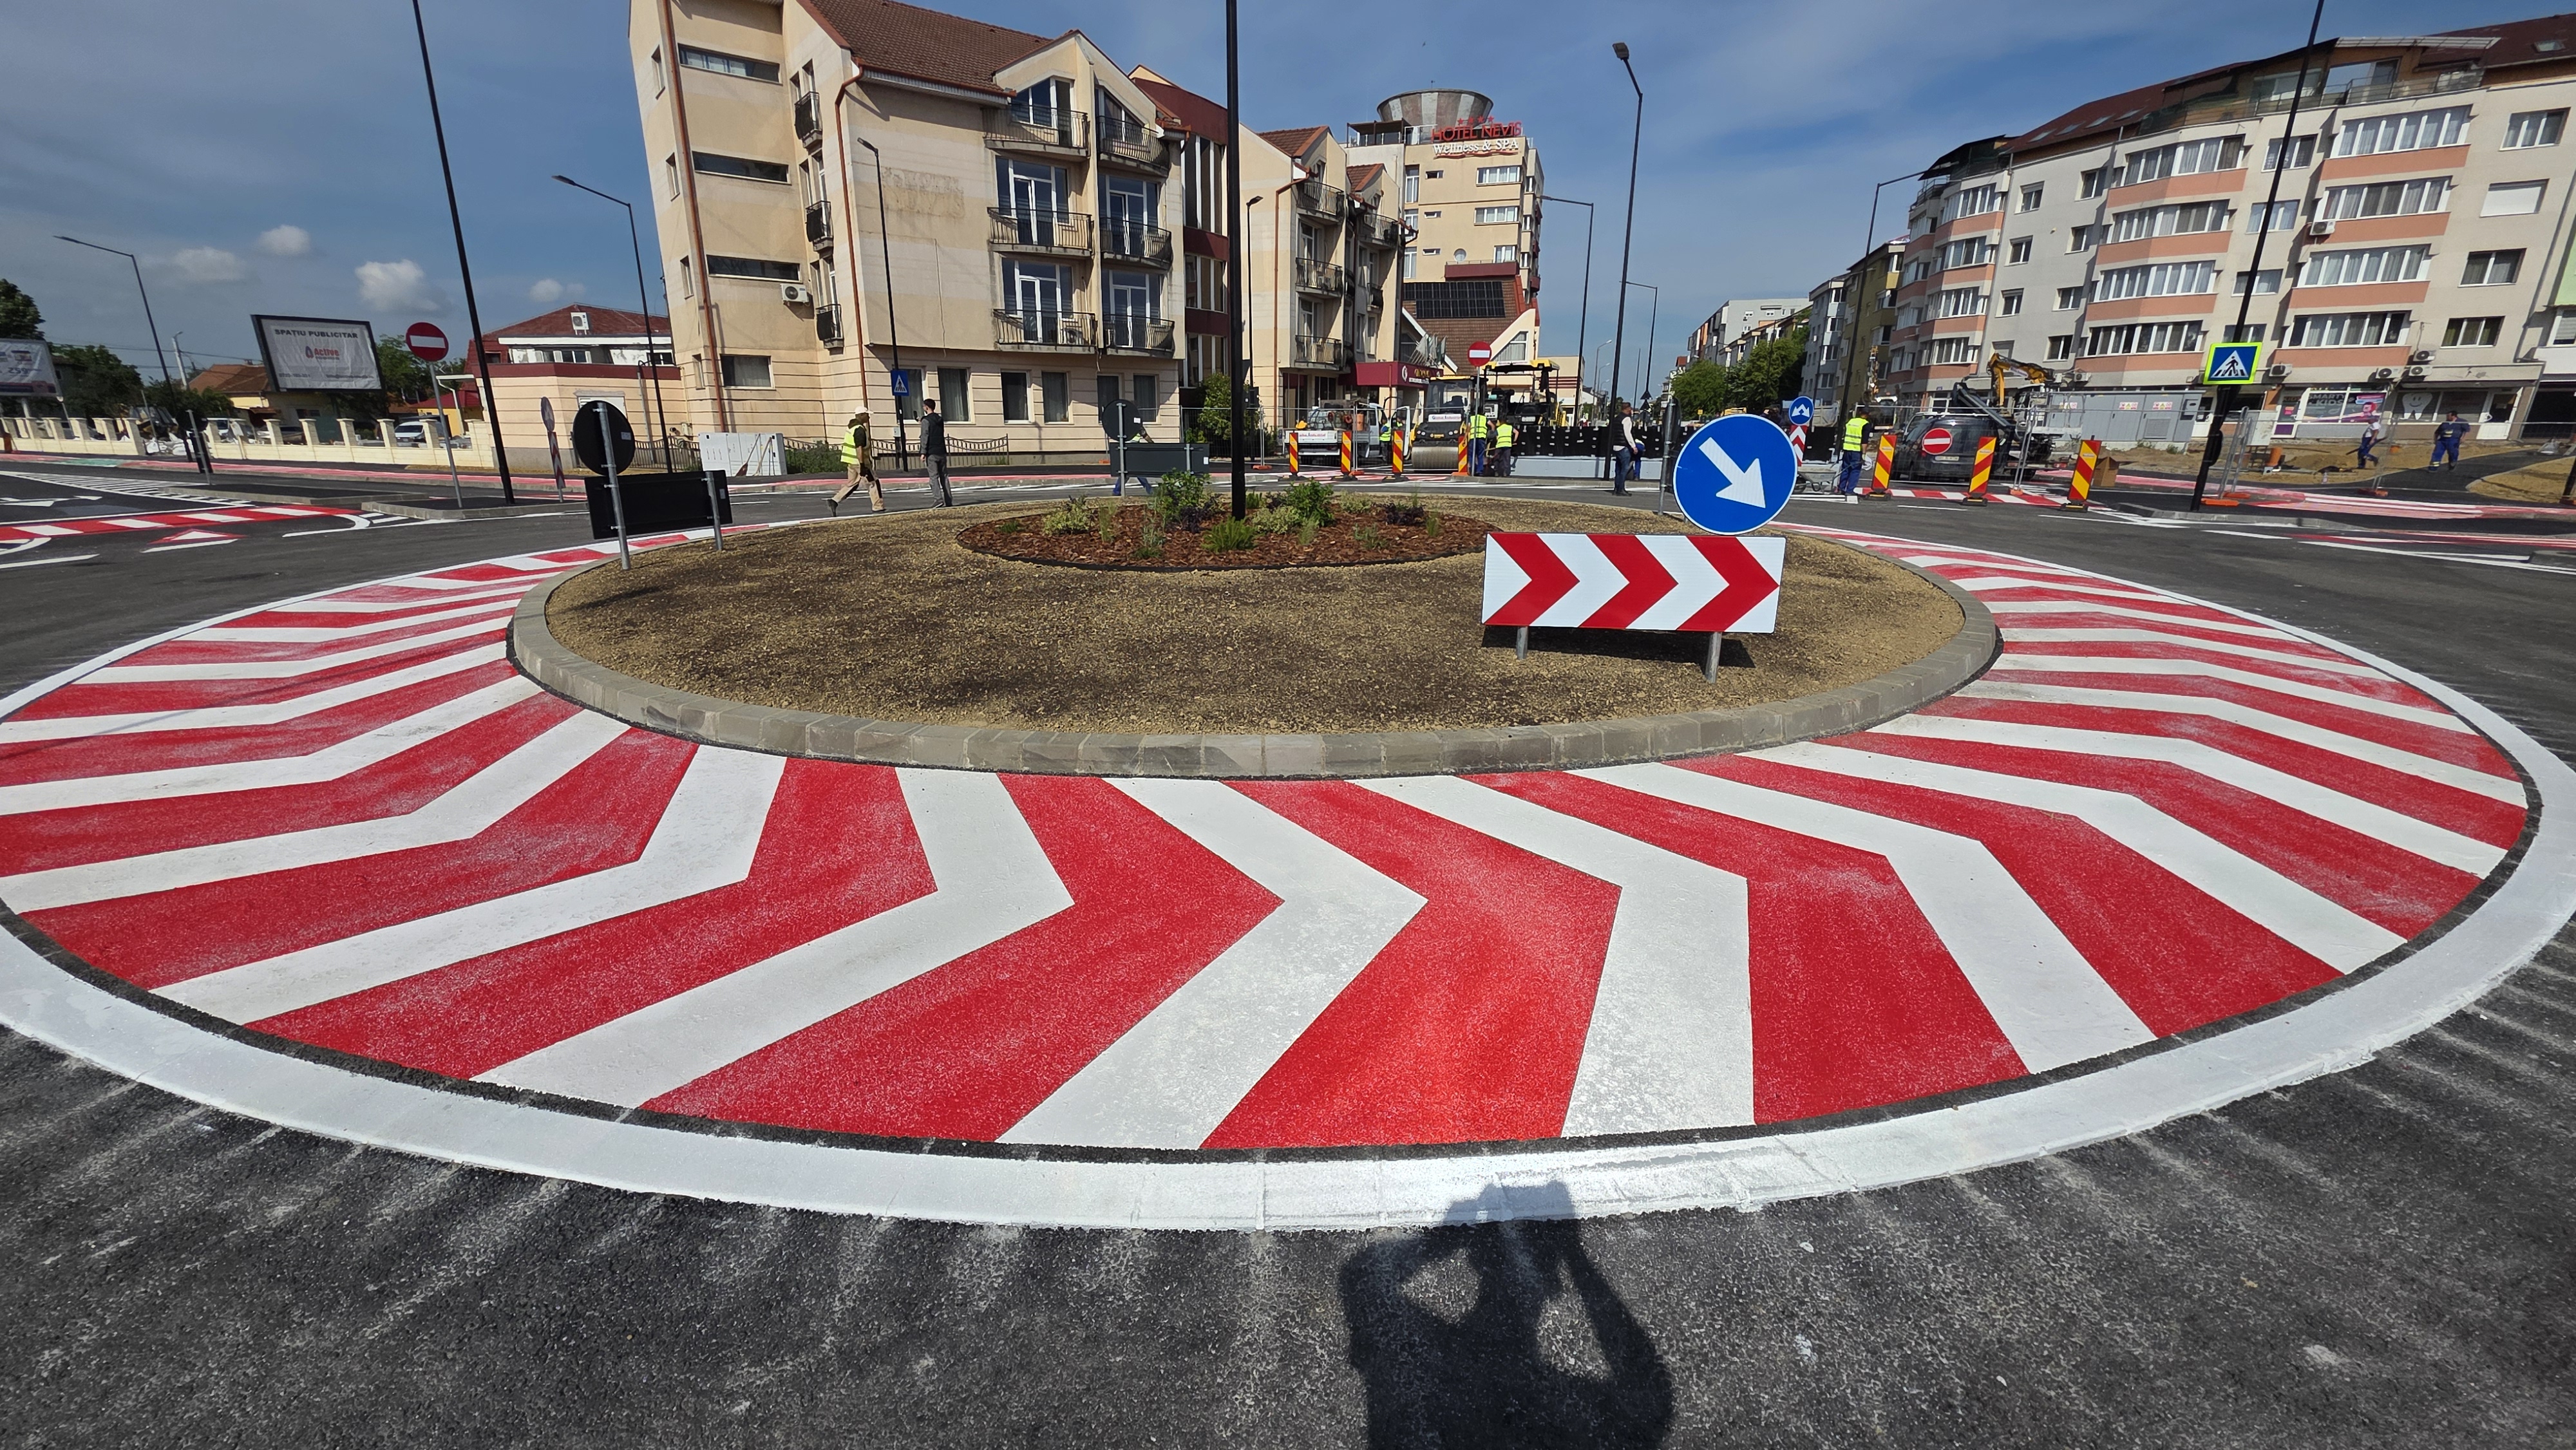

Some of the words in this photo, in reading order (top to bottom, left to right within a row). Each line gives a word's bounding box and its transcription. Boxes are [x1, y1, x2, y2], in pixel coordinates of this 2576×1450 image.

[1431, 126, 1477, 143] HOTEL
[1482, 122, 1522, 138] NEVIS
[1433, 144, 1479, 154] Wellness
[1482, 140, 1491, 150] &
[1495, 137, 1519, 149] SPA
[314, 348, 340, 357] Active
